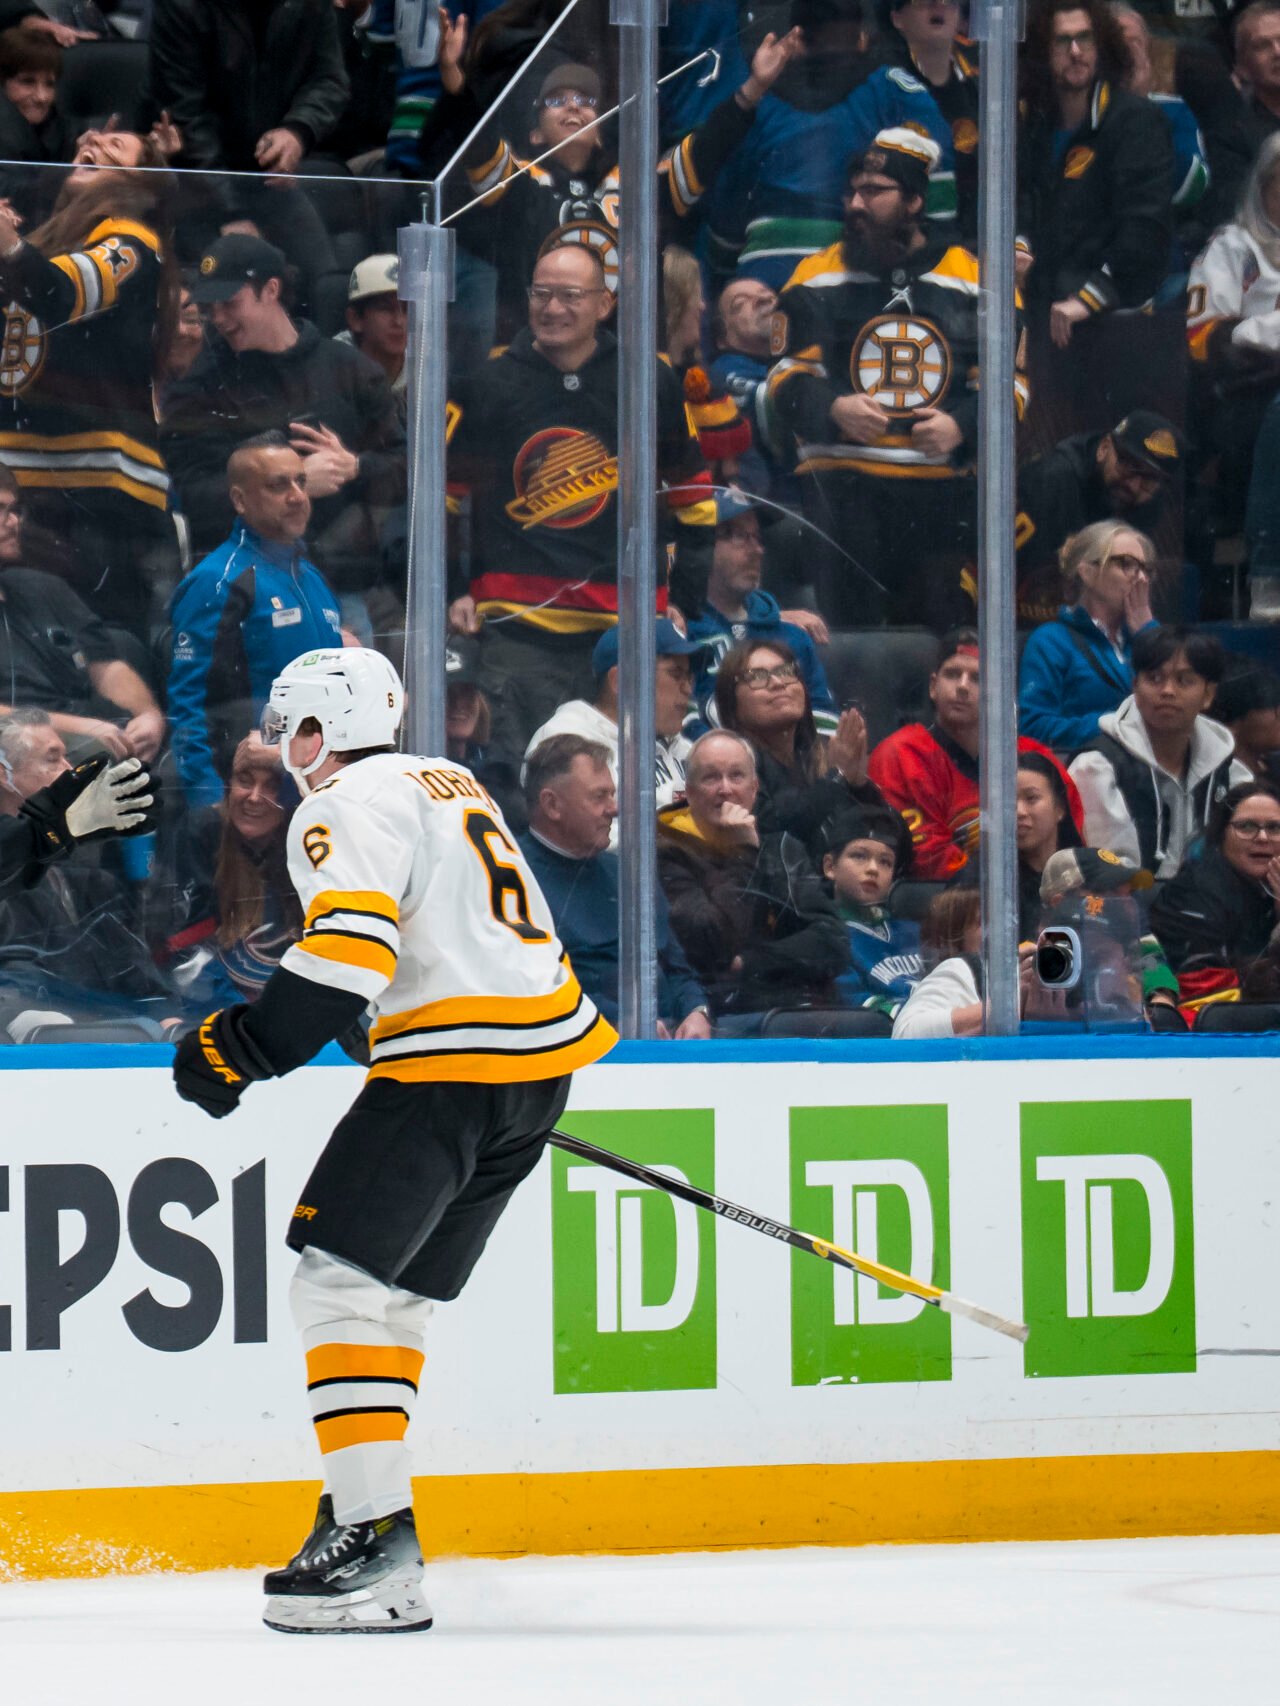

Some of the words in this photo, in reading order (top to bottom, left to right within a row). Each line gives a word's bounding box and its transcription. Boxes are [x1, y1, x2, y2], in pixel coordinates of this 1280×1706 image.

[387, 692, 394, 708] 6
[303, 824, 331, 870] 6
[463, 808, 552, 944] 6
[567, 1164, 699, 1333] TD
[806, 1159, 934, 1326] TD
[1036, 1154, 1176, 1319] TD
